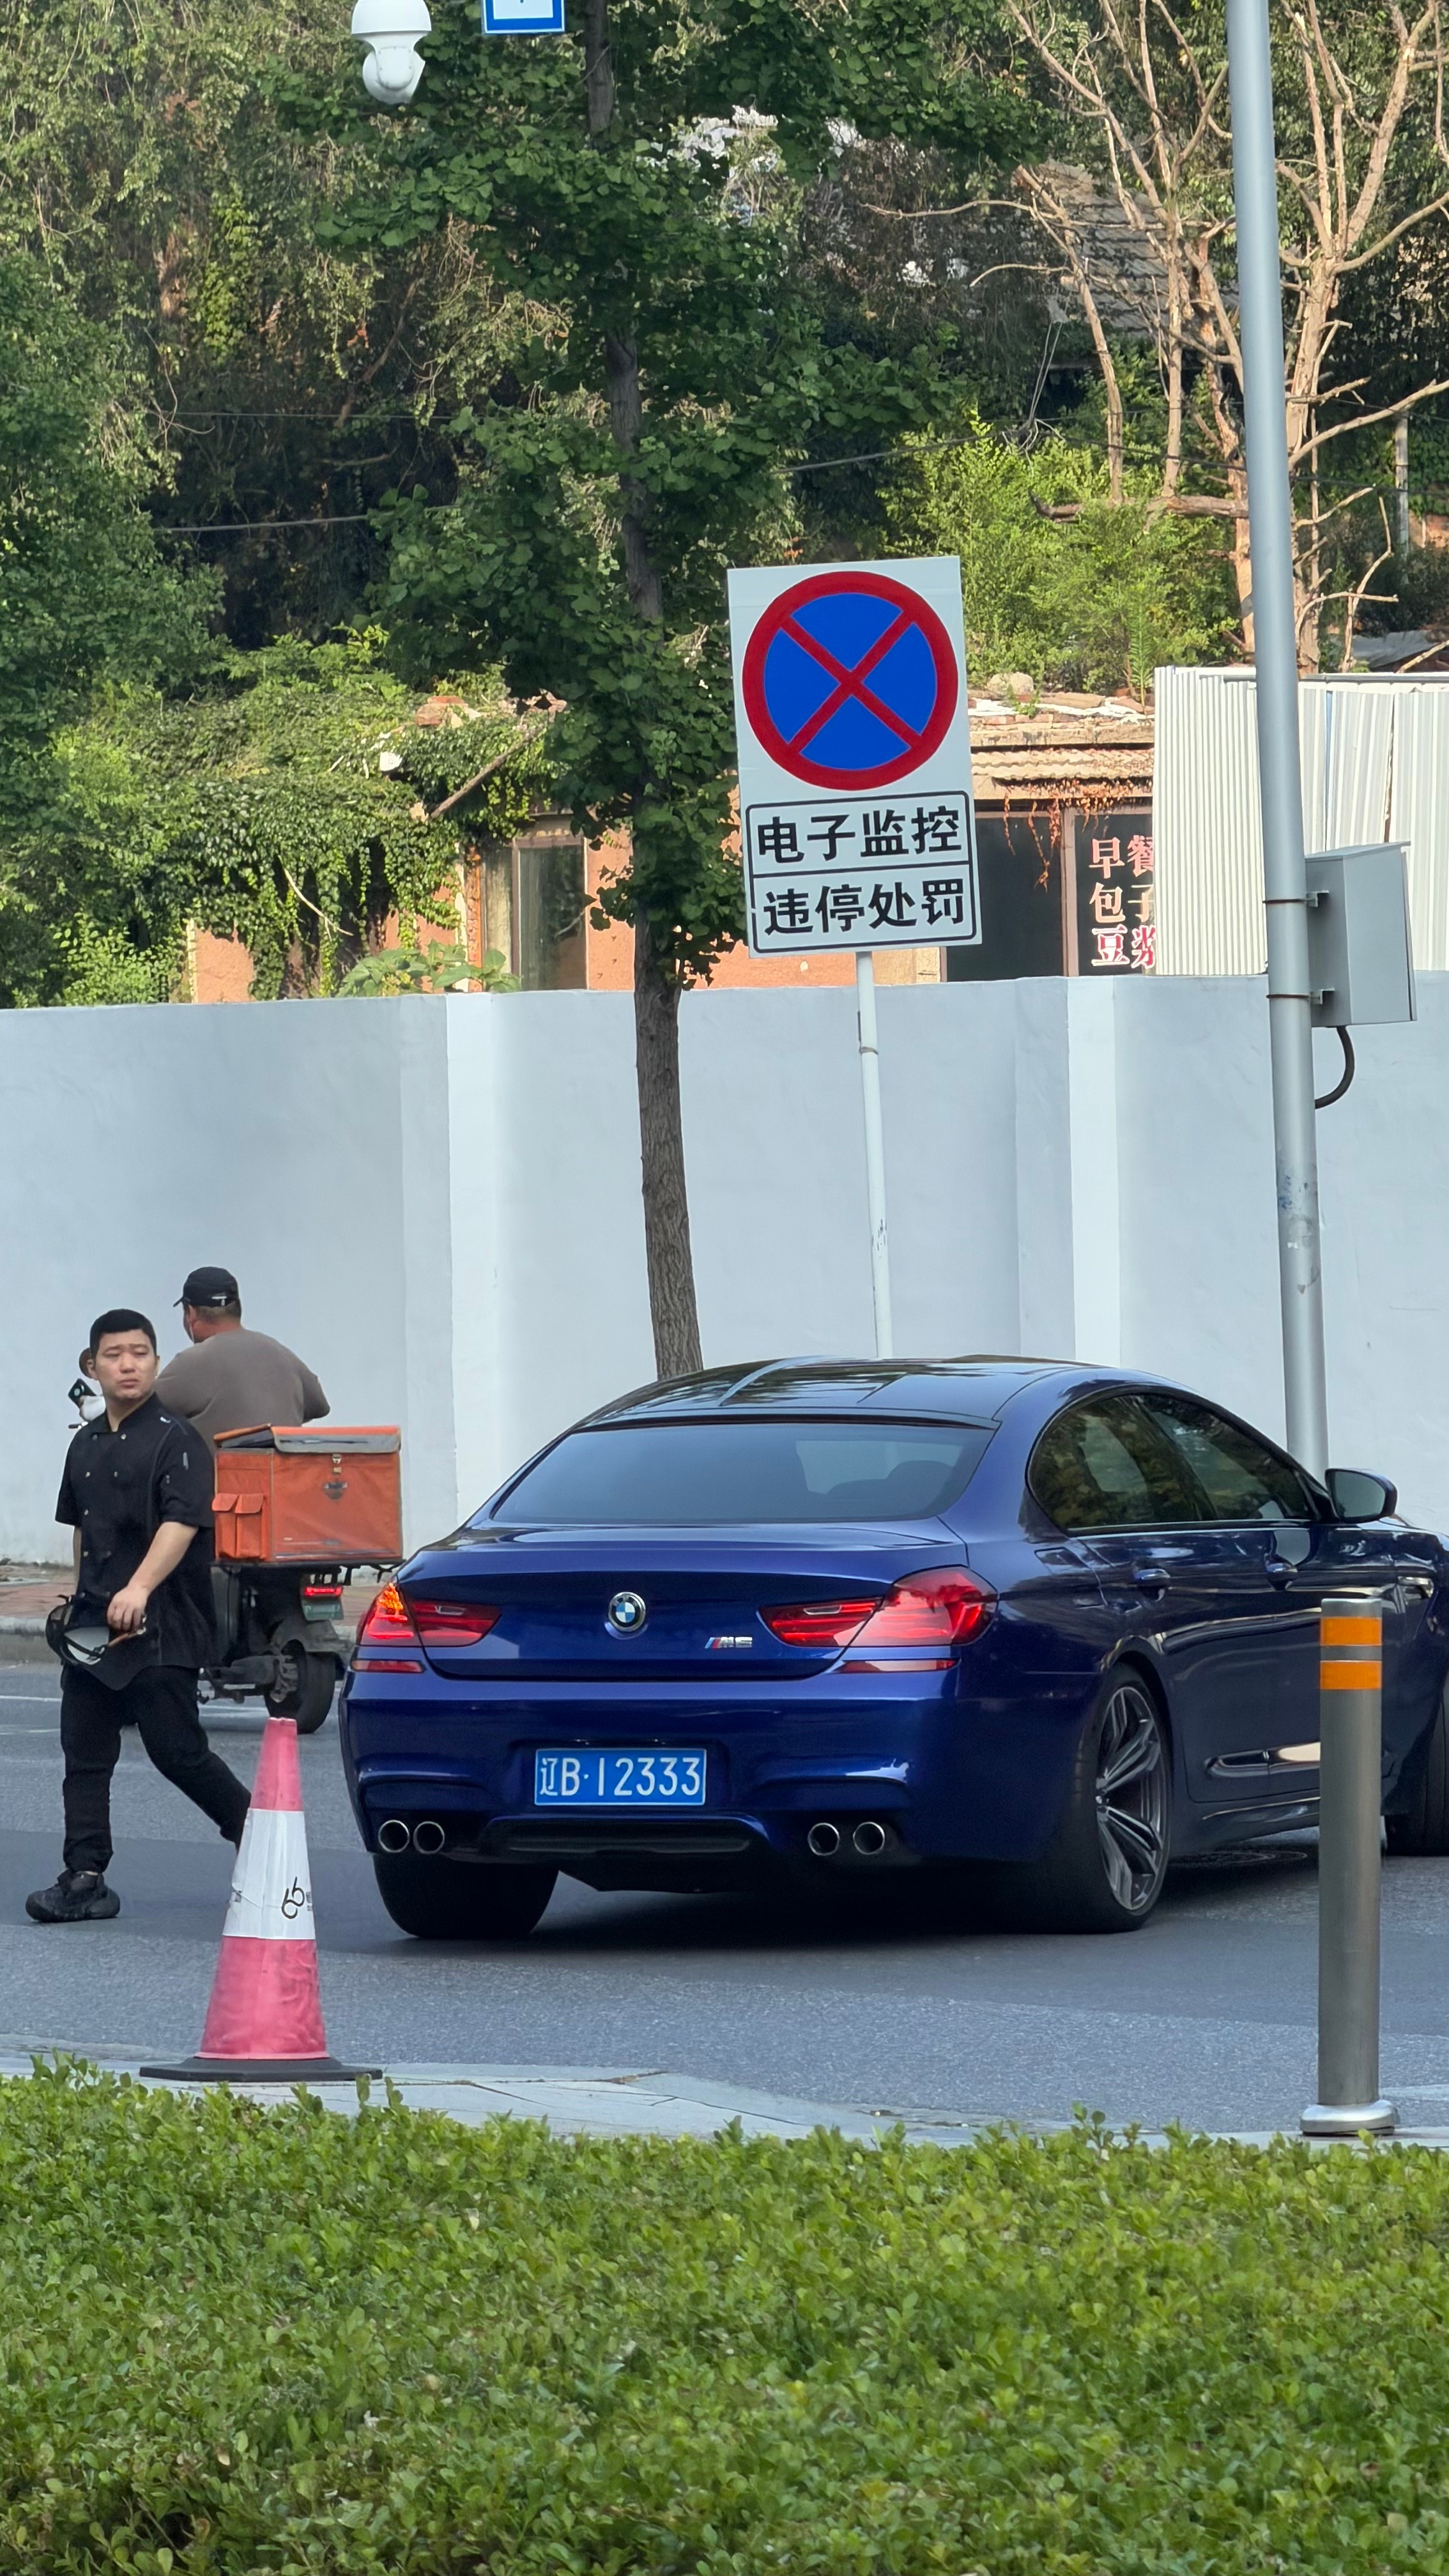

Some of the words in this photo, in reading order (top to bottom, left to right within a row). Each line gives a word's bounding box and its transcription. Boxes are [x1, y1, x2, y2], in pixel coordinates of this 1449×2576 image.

[757, 806, 962, 863] 电子监控
[763, 878, 963, 935] 违停处罚
[1089, 882, 1154, 923] 包子
